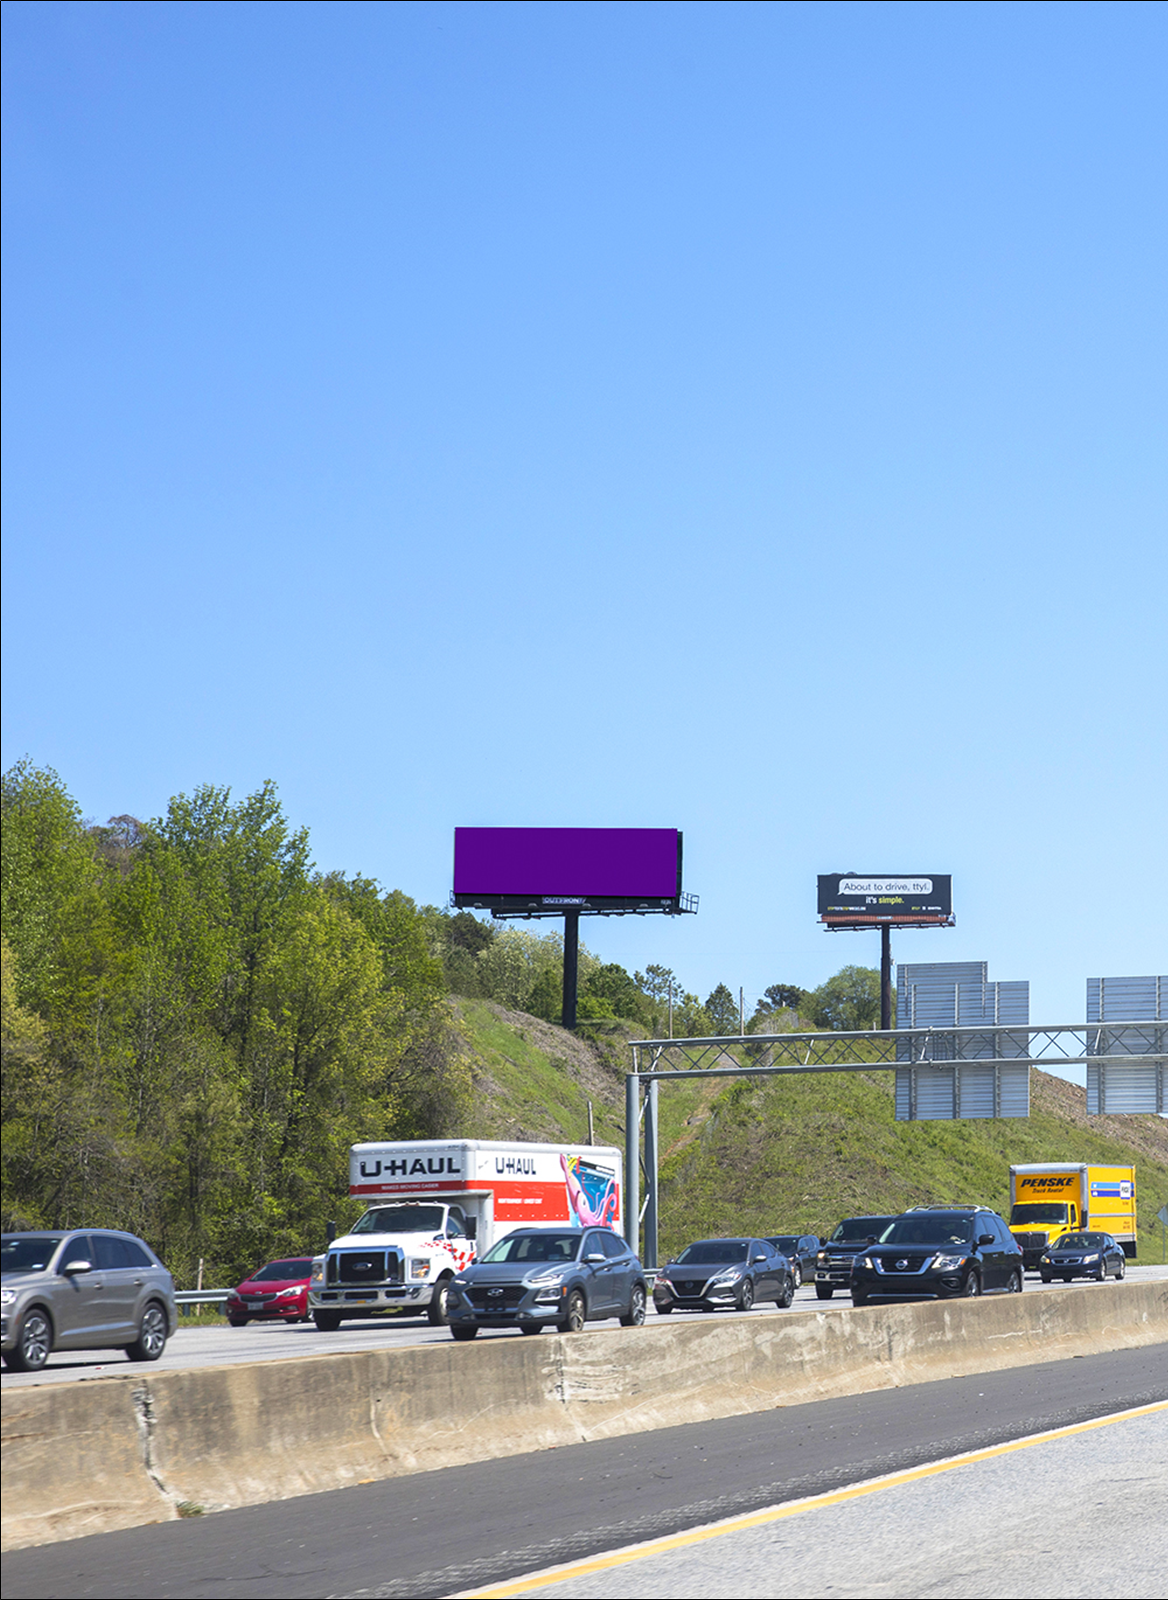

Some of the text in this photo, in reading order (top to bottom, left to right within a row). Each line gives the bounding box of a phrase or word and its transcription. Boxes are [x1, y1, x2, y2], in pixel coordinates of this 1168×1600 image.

[844, 883, 871, 891] About
[874, 883, 883, 891] to
[885, 883, 910, 891] drive,
[866, 896, 904, 905] it's simple.
[360, 1158, 461, 1177] U-HAUL
[495, 1157, 536, 1175] U-HAUL
[1020, 1177, 1075, 1188] PENSKE
